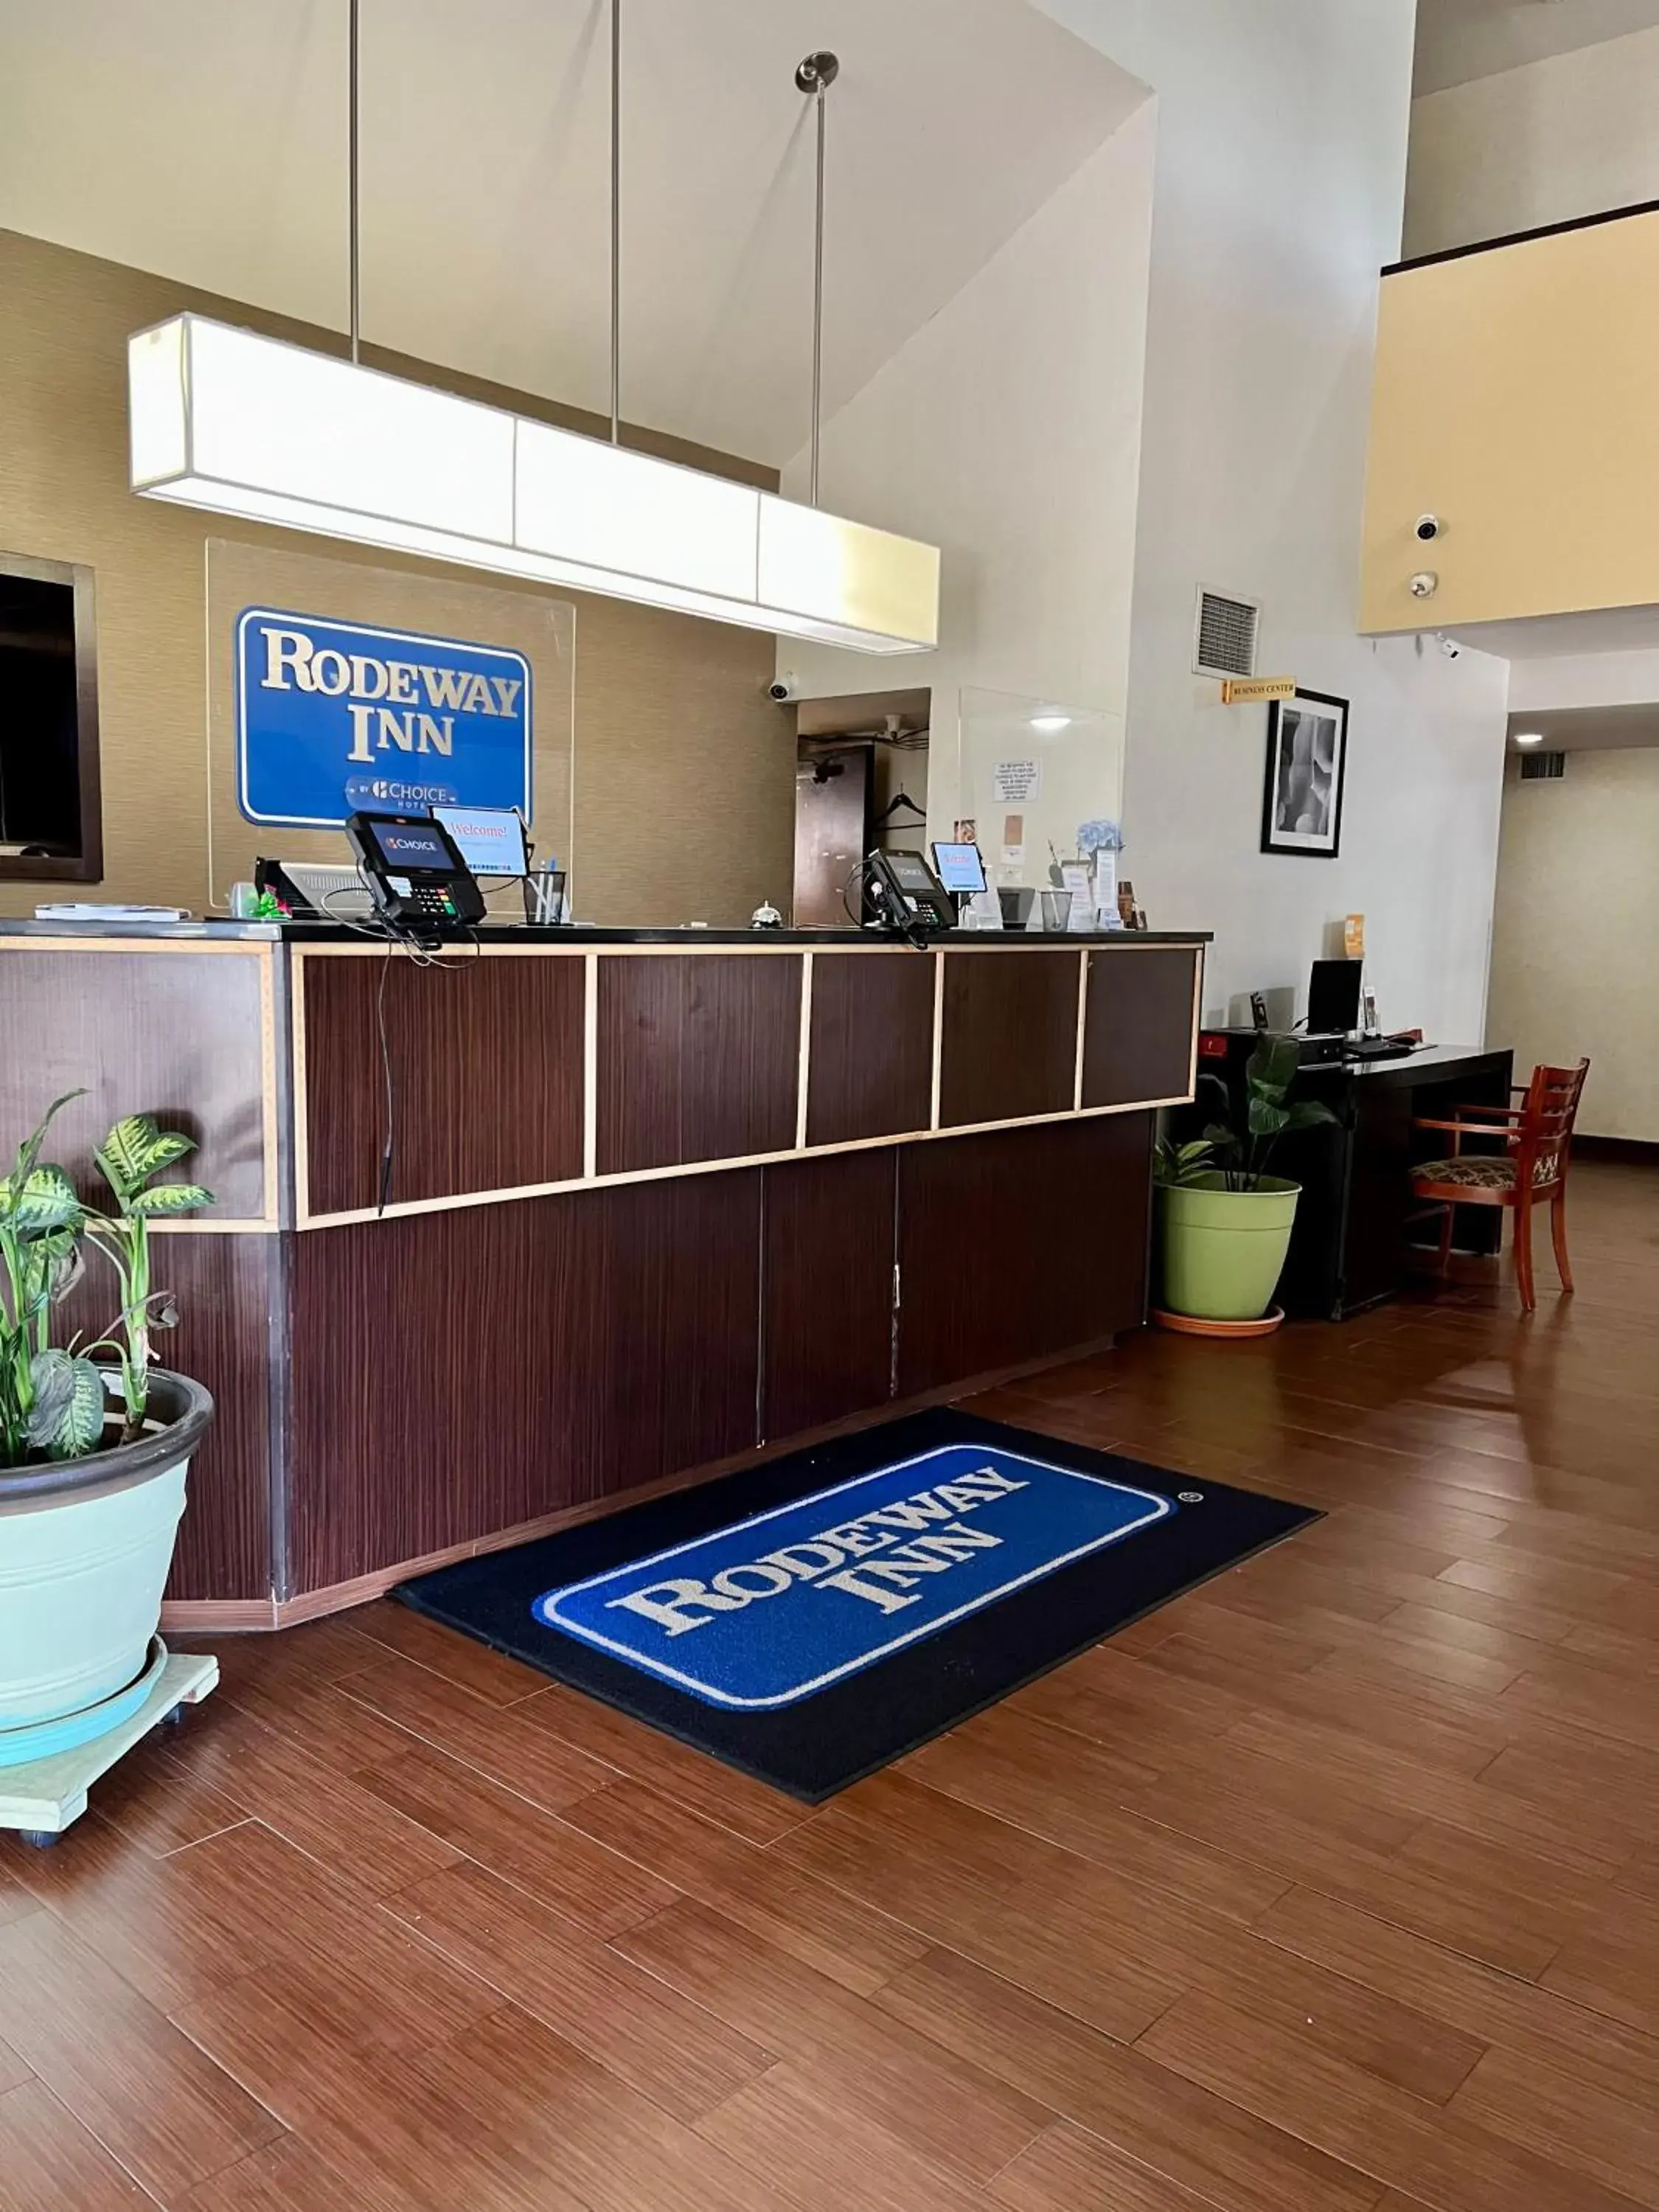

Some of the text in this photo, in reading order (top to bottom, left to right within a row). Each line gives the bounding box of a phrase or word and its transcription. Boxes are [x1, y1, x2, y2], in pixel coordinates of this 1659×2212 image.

[260, 627, 522, 718] RODEWAY
[347, 703, 454, 762] INN
[389, 782, 447, 802] CHOICE
[397, 838, 437, 851] CHOICE
[452, 822, 507, 838] Welcome!
[605, 1466, 1031, 1637] RODEWAY
[813, 1522, 1006, 1616] INN
